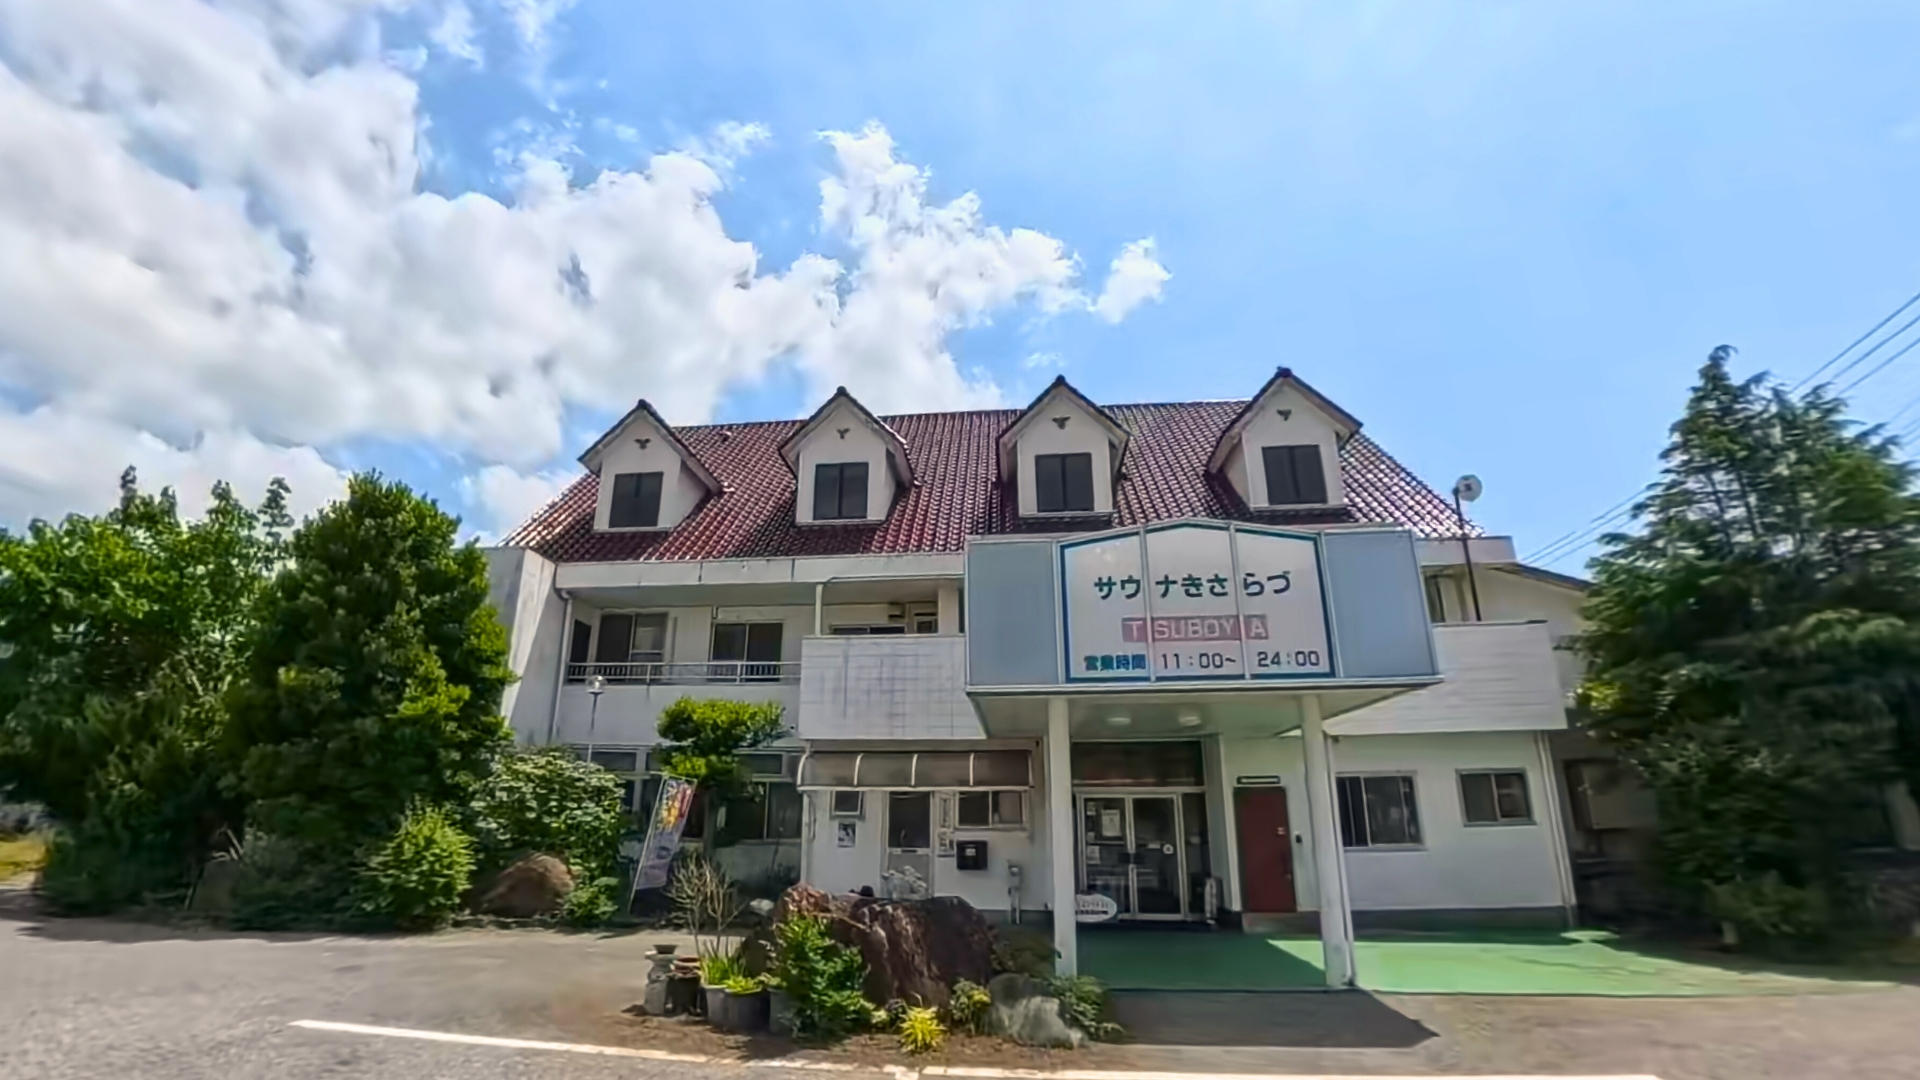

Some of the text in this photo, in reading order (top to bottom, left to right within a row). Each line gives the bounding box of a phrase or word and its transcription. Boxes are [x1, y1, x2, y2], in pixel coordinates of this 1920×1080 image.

[1093, 570, 1291, 600] サウナきさらづ
[1125, 619, 1267, 638] TSUBOYA
